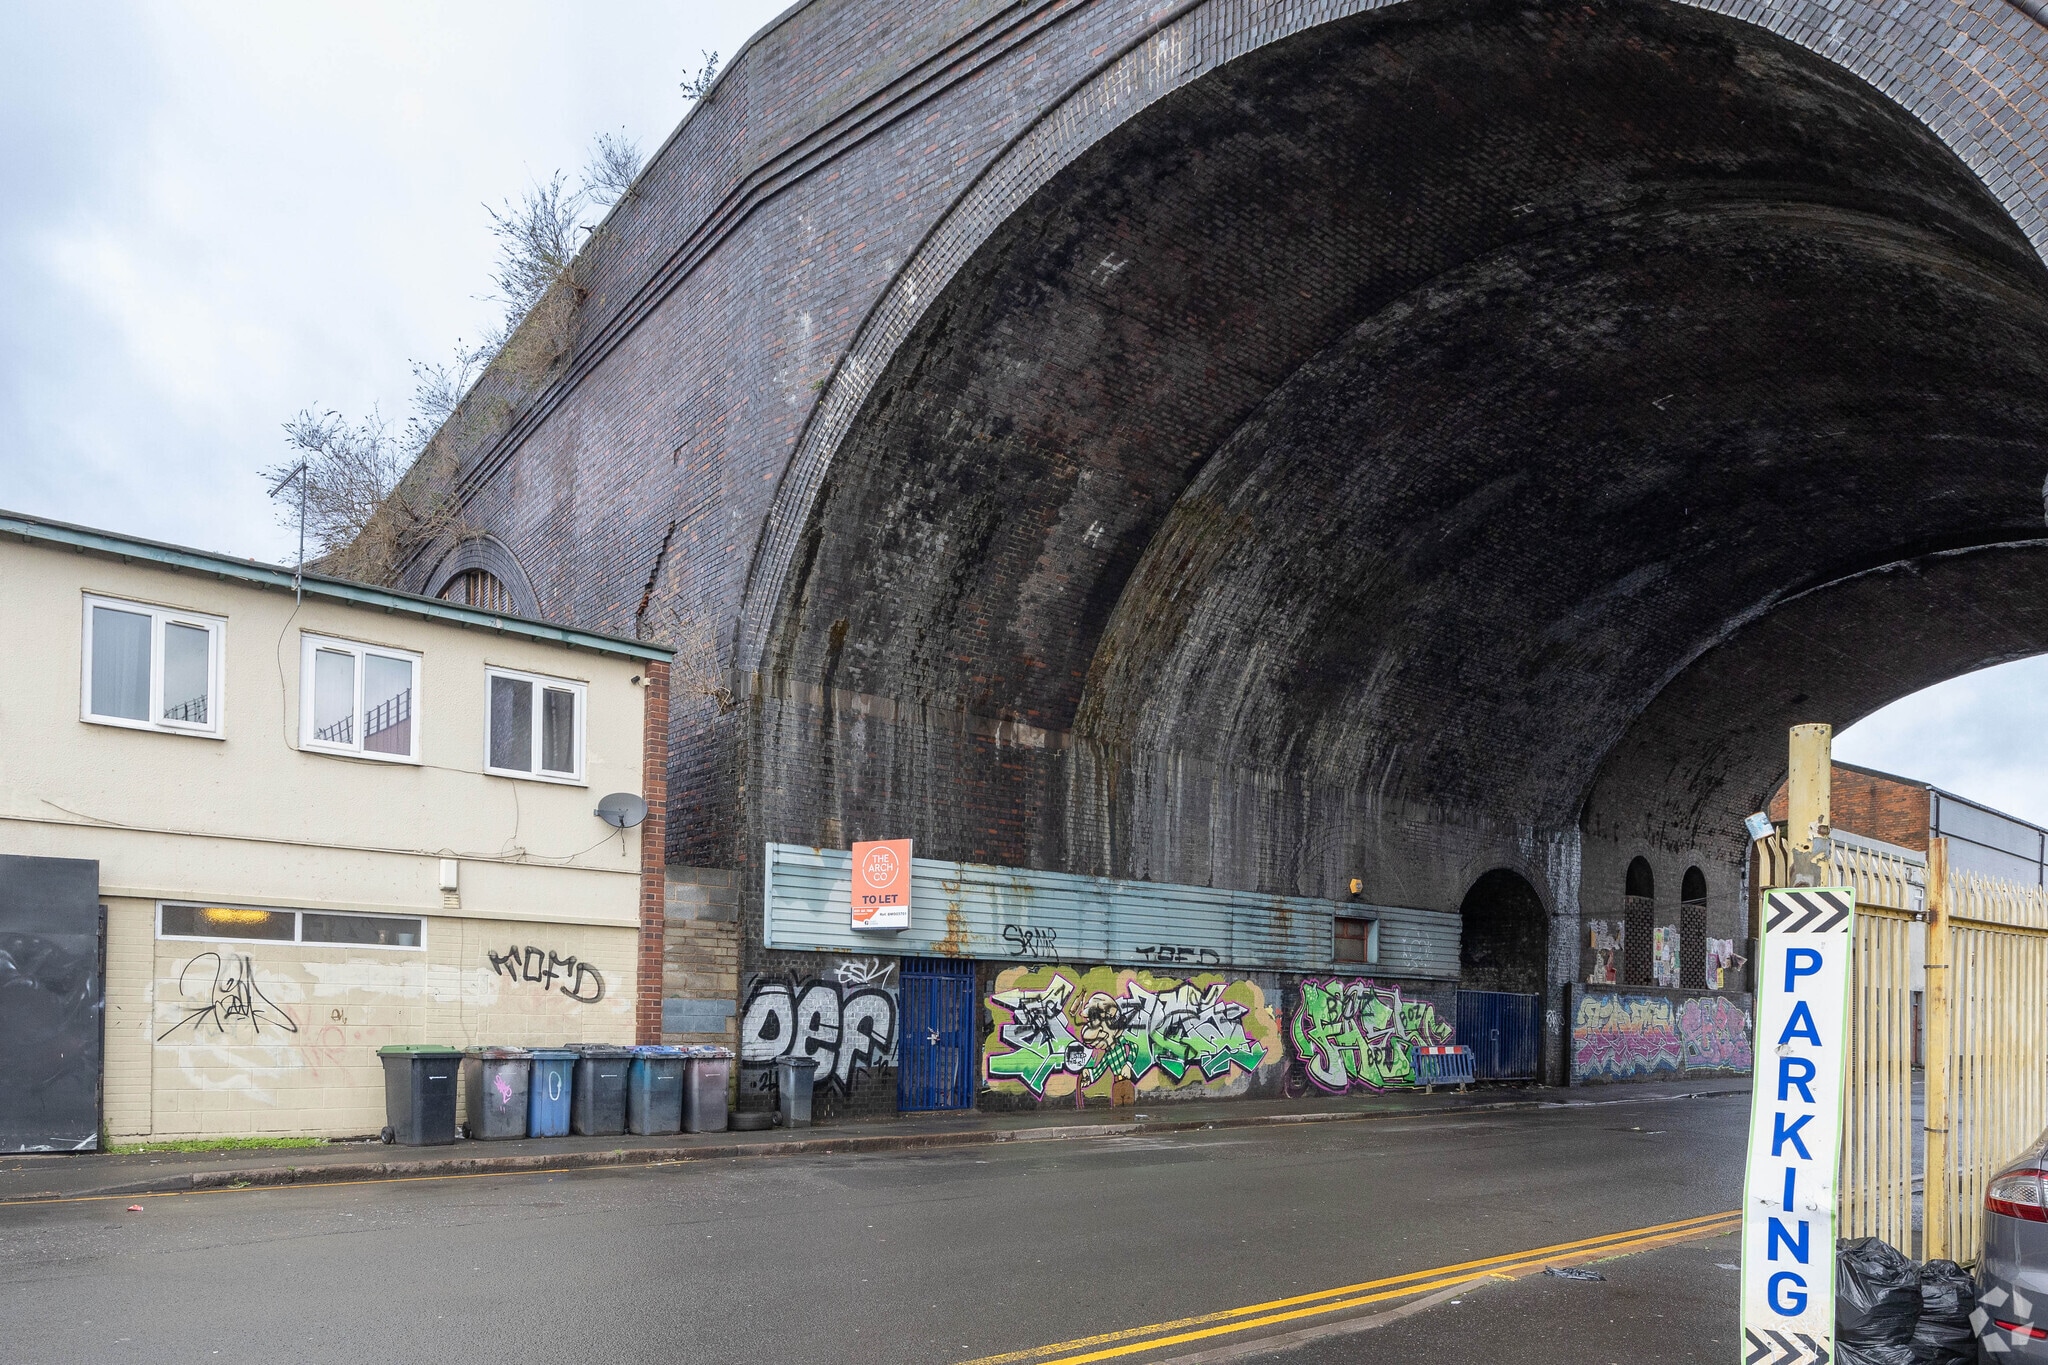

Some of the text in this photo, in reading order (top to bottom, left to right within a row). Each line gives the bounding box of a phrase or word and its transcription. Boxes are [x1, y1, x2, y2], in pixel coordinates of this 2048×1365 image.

[872, 854, 889, 863] THE
[868, 863, 893, 873] ARCH
[873, 872, 888, 881] CO
[862, 894, 898, 904] TO LET
[1767, 947, 1823, 1317] PARKING
